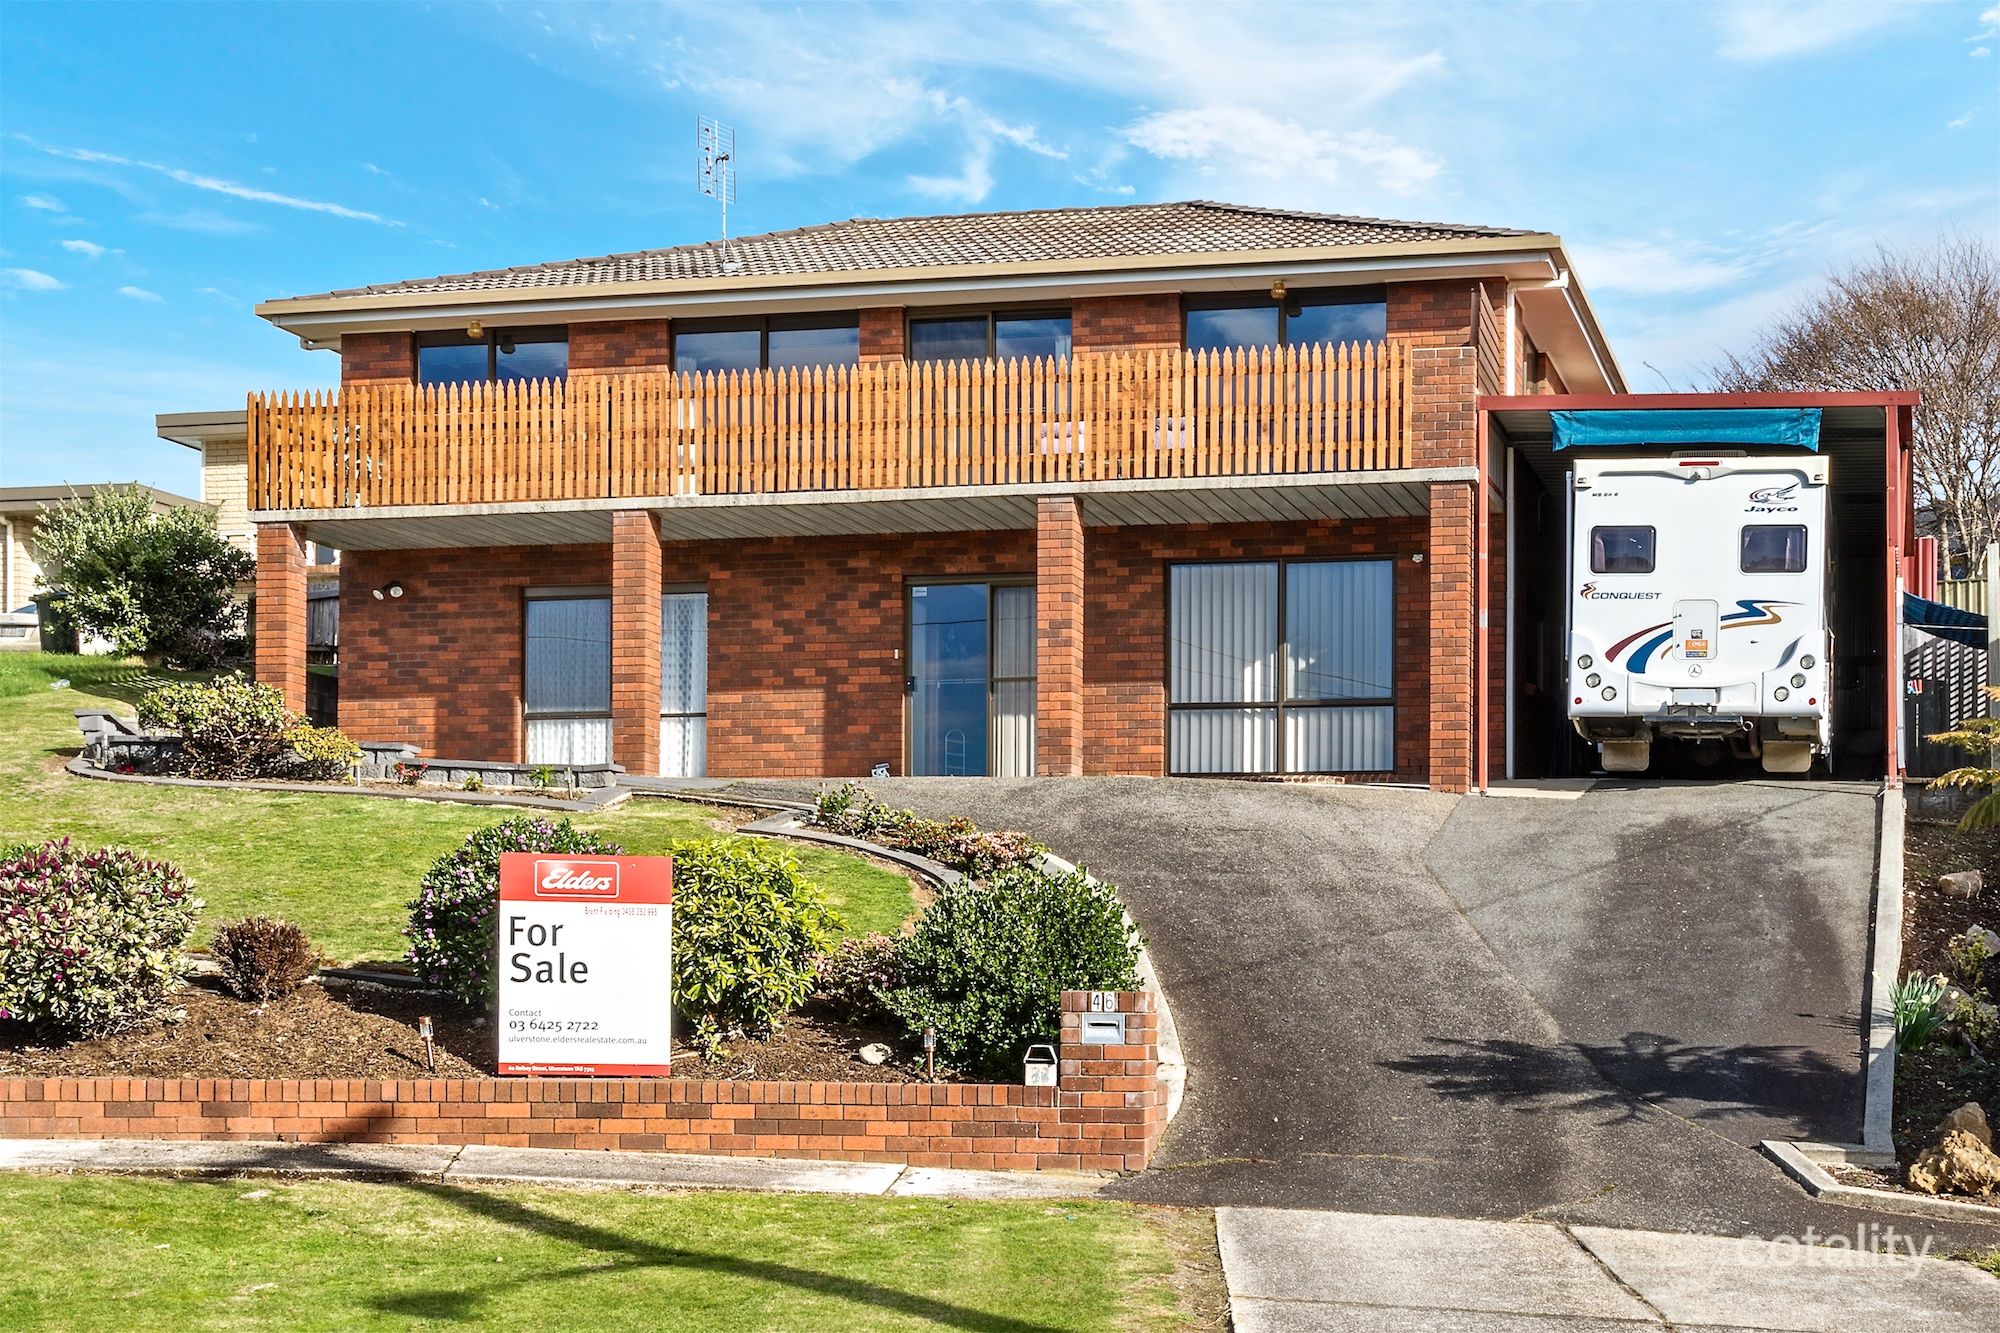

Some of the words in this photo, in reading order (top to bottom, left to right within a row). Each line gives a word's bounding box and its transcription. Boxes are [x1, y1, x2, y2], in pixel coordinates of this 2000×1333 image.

[1744, 506, 1798, 514] Jayco
[1591, 592, 1662, 600] CONQUEST
[541, 866, 613, 891] Elders
[509, 916, 564, 947] For
[510, 952, 588, 983] Sale
[1093, 994, 1114, 1010] 46
[508, 1008, 542, 1017] Contact
[509, 1020, 525, 1032] 03
[529, 1018, 562, 1032] 6425
[566, 1021, 599, 1033] 2722
[508, 1035, 647, 1045] ulverstone.eldersrealestate.com.au
